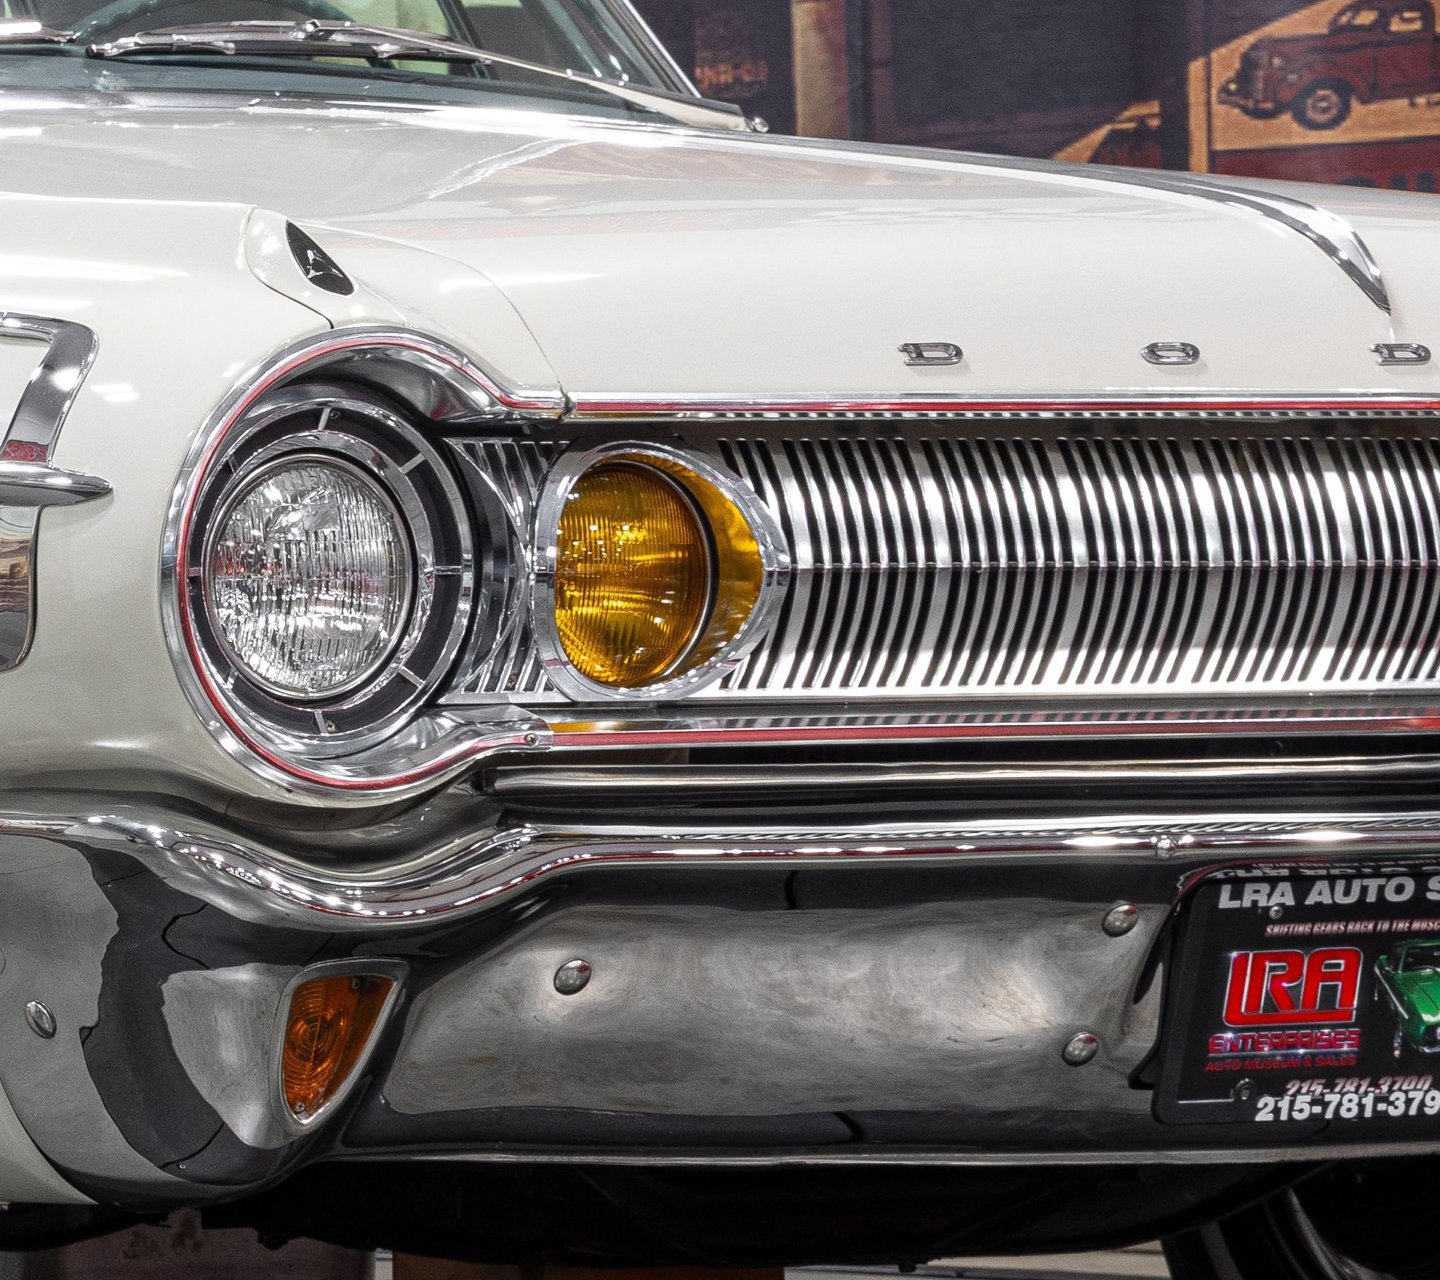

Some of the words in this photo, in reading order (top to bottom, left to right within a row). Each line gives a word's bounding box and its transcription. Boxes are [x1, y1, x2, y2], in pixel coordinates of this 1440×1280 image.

[1218, 881, 1296, 909] LRA
[1305, 876, 1415, 905] AUTO
[1265, 923, 1313, 937] SHIFTING
[1313, 922, 1347, 935] GEARS
[1347, 921, 1374, 933] BACK
[1376, 921, 1390, 933] TO
[1391, 920, 1410, 932] THE
[1223, 946, 1365, 1027] LRA
[1208, 1029, 1362, 1054] ENTERPRISES
[1205, 1060, 1242, 1071] AUTO
[1245, 1056, 1303, 1070] MUSEUM
[1304, 1057, 1313, 1067] &
[1315, 1055, 1358, 1067] SALES
